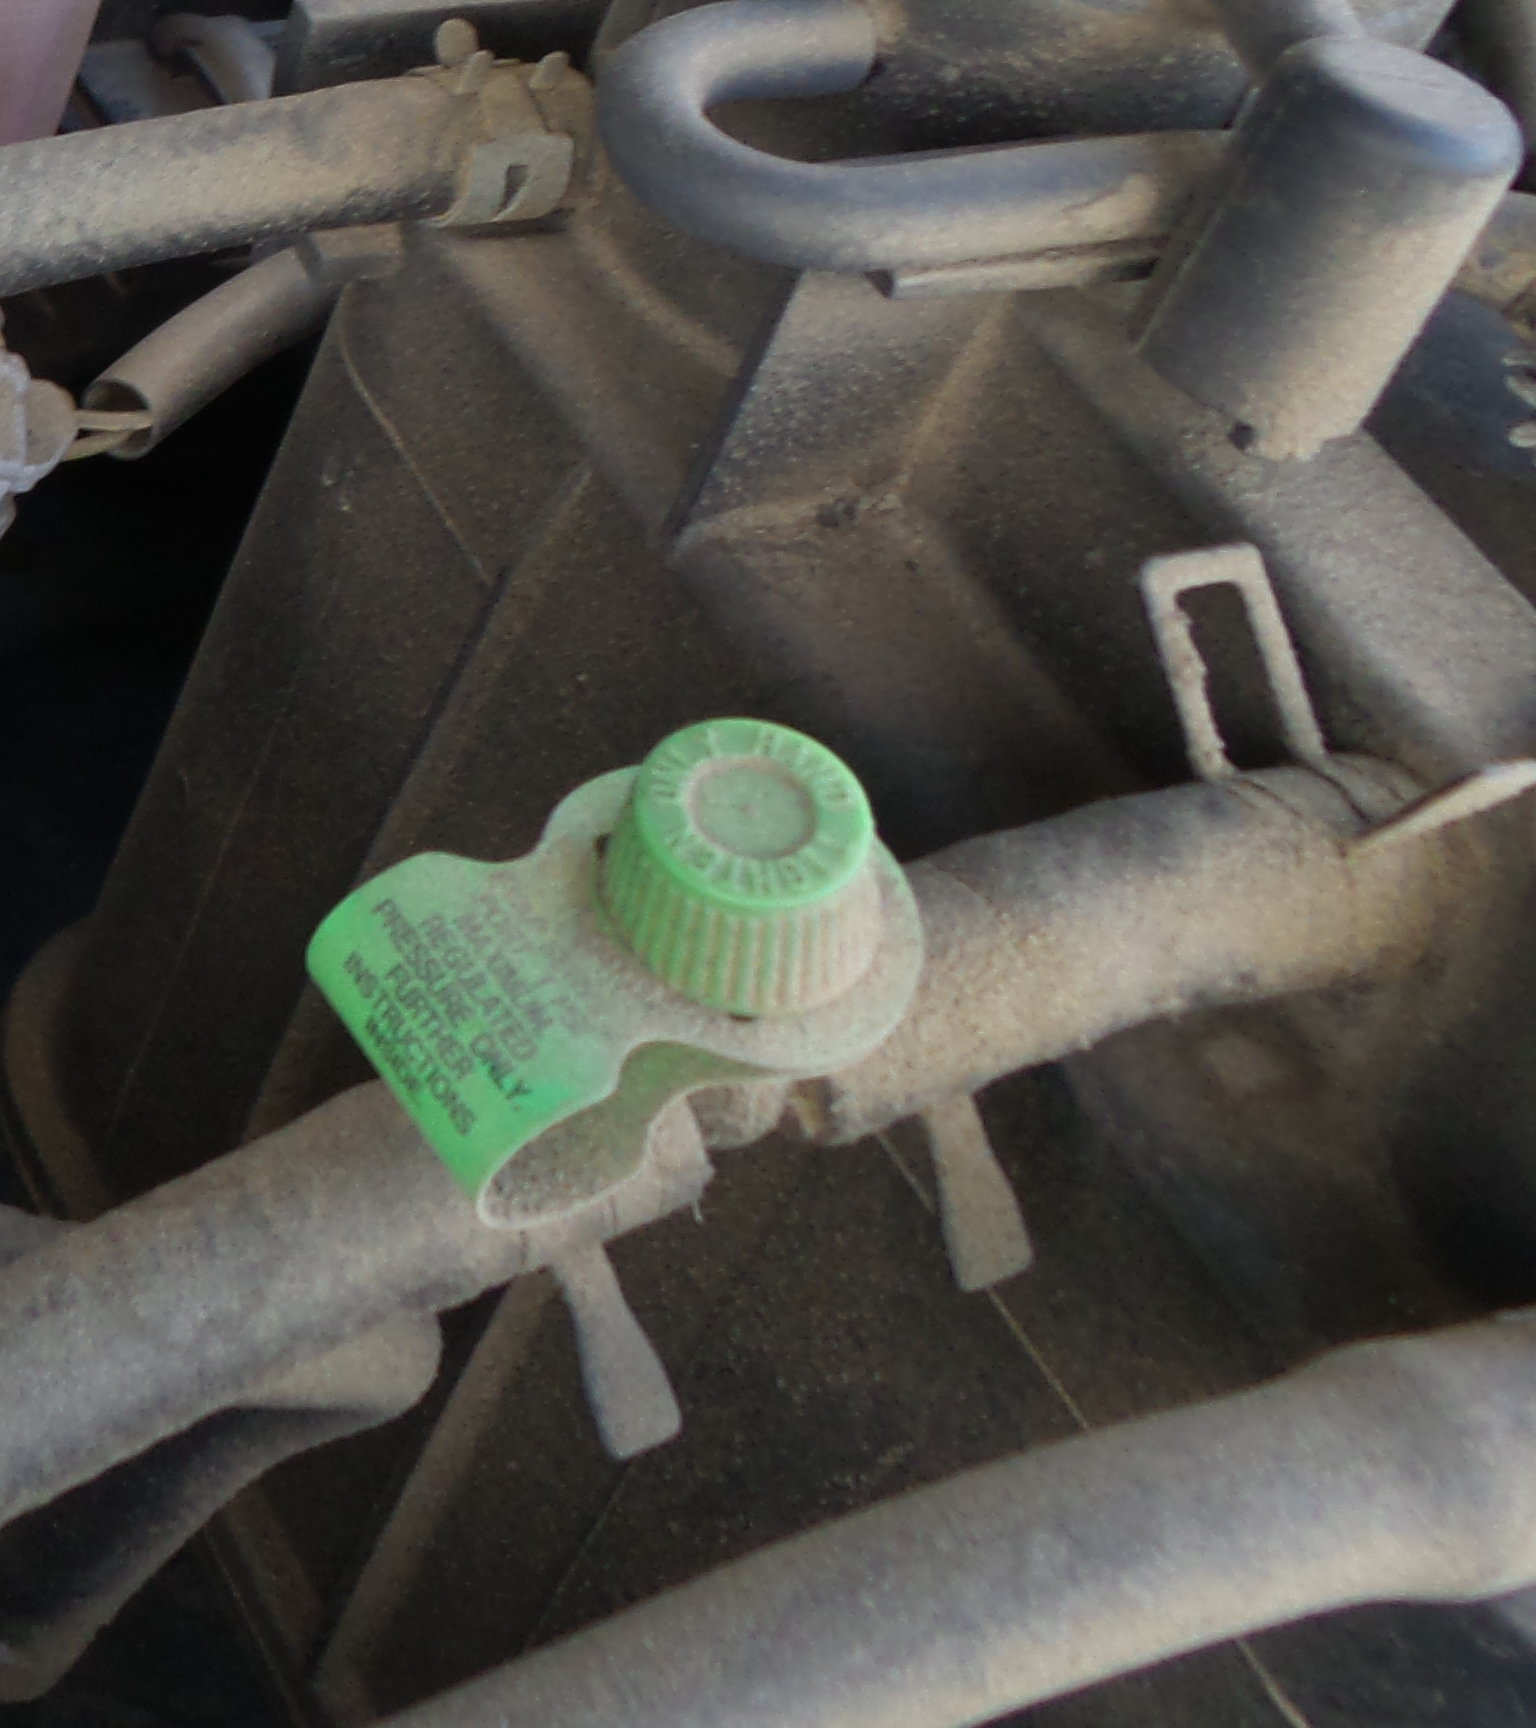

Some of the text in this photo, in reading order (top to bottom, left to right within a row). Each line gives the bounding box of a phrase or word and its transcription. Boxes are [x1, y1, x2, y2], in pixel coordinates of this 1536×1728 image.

[370, 898, 475, 1030] PRESSURE
[383, 964, 476, 1081] FURTHER
[421, 913, 540, 1063] REGULATED
[341, 951, 477, 1136] INSTRUCTIONS
